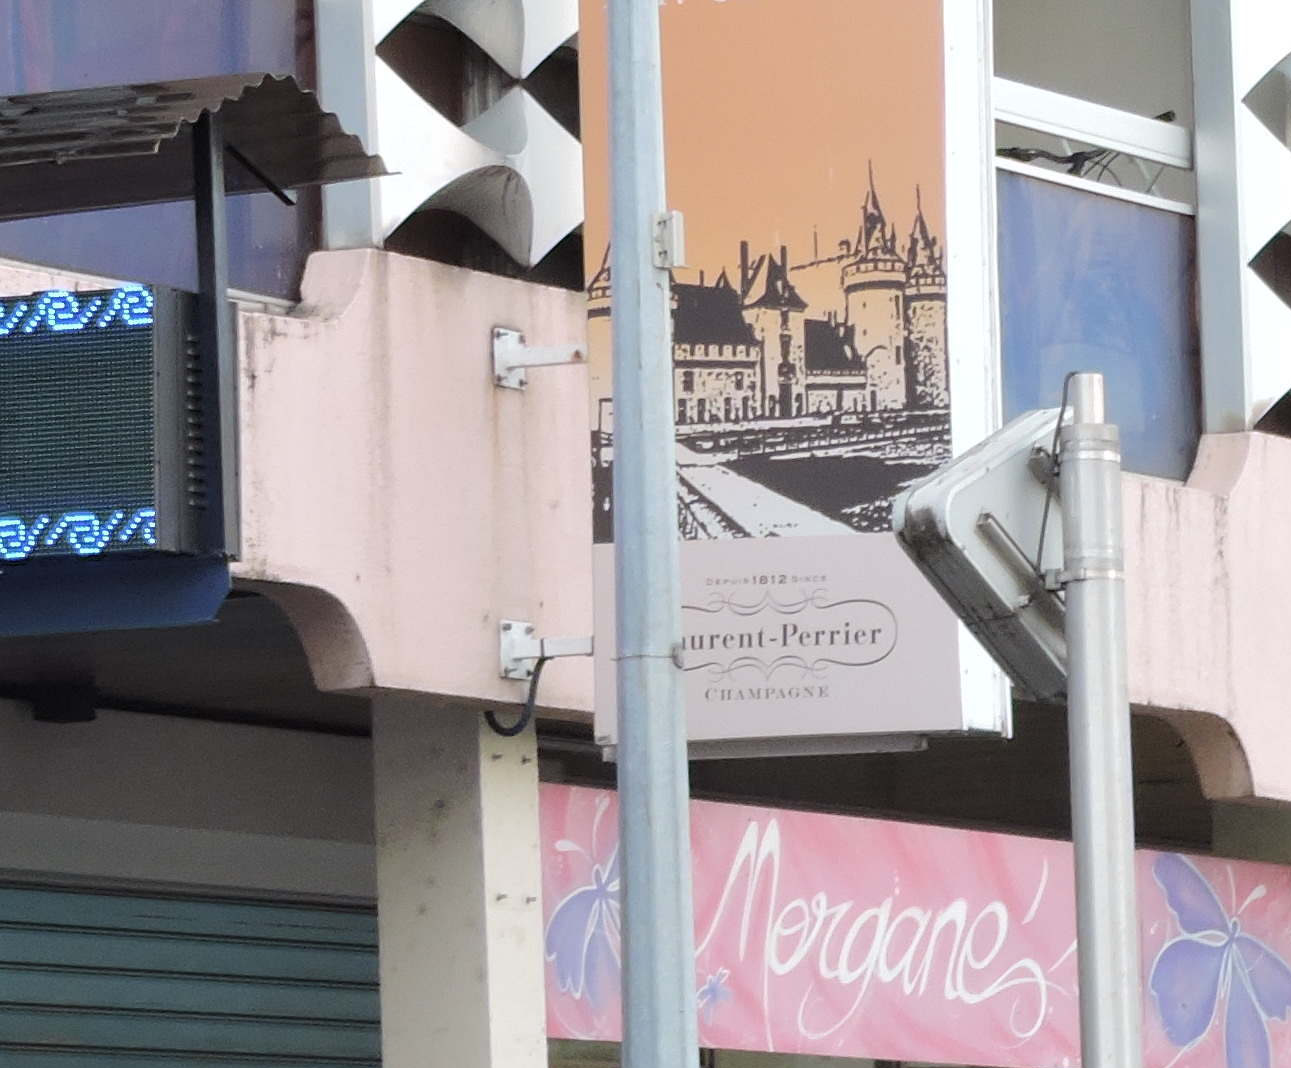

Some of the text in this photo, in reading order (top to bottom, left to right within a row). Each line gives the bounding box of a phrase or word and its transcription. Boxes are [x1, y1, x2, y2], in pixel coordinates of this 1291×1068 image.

[751, 574, 787, 585] 1812
[682, 621, 882, 650] urent-Perrier
[704, 684, 830, 702] CHAMPAGNE
